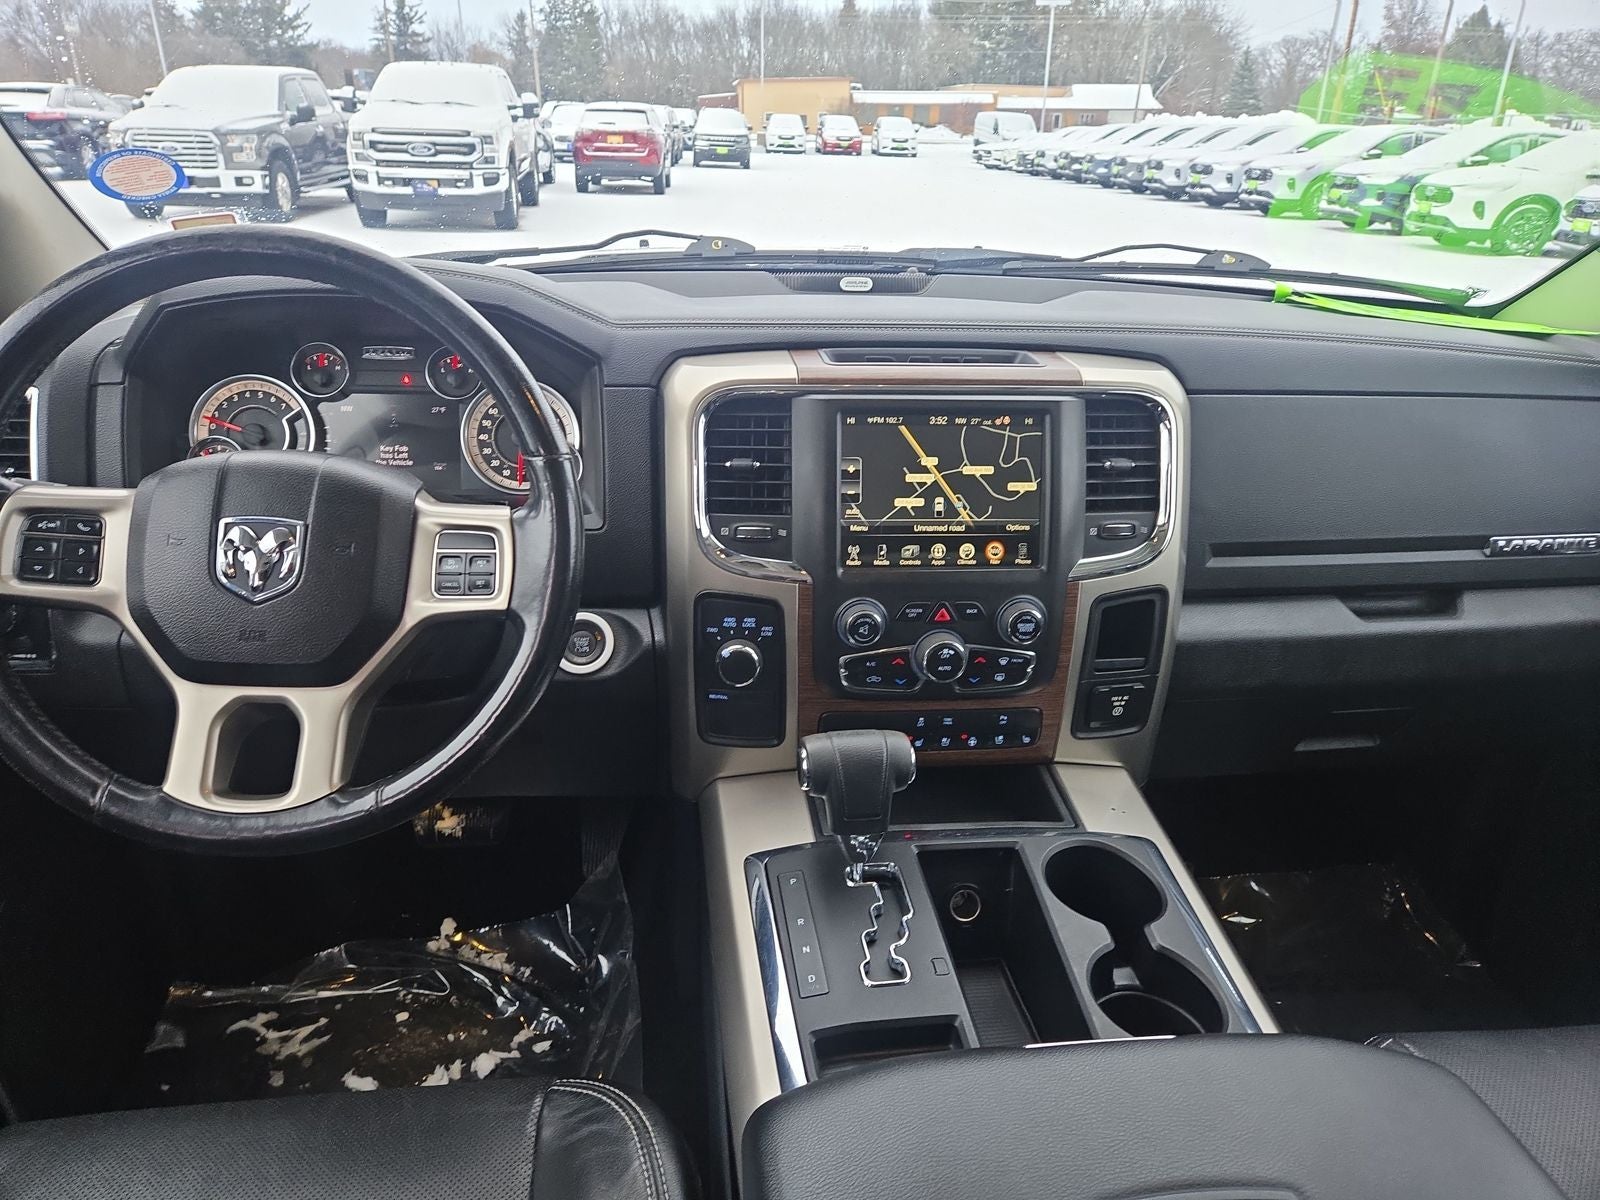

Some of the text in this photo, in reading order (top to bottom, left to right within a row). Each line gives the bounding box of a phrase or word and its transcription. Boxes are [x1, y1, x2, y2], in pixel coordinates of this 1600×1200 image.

[929, 416, 948, 425] 3:52
[380, 445, 393, 453] Key
[1006, 524, 1030, 532] Options
